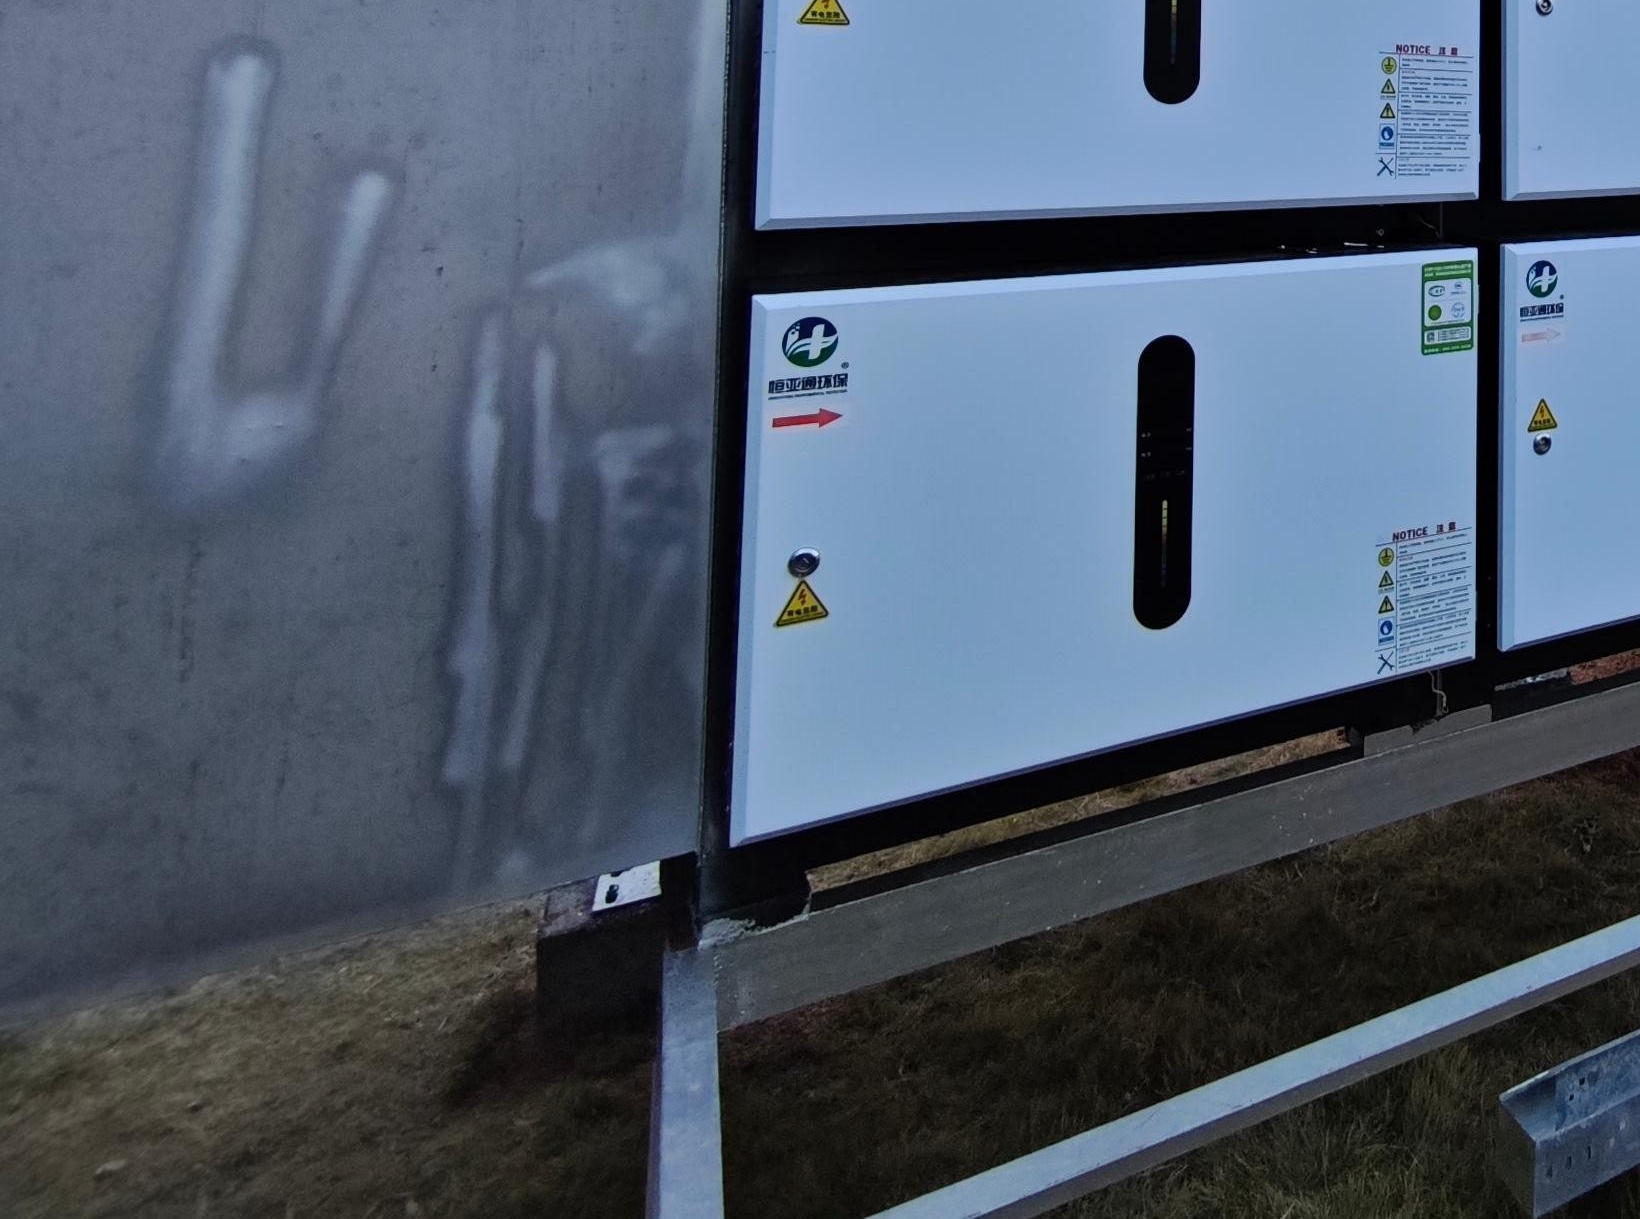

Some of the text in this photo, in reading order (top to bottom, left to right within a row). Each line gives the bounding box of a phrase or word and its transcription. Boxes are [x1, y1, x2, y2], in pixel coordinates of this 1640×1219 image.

[1396, 44, 1430, 55] NOTICE
[768, 372, 848, 394] 恒亚通环保
[1392, 526, 1428, 541] NOTICE
